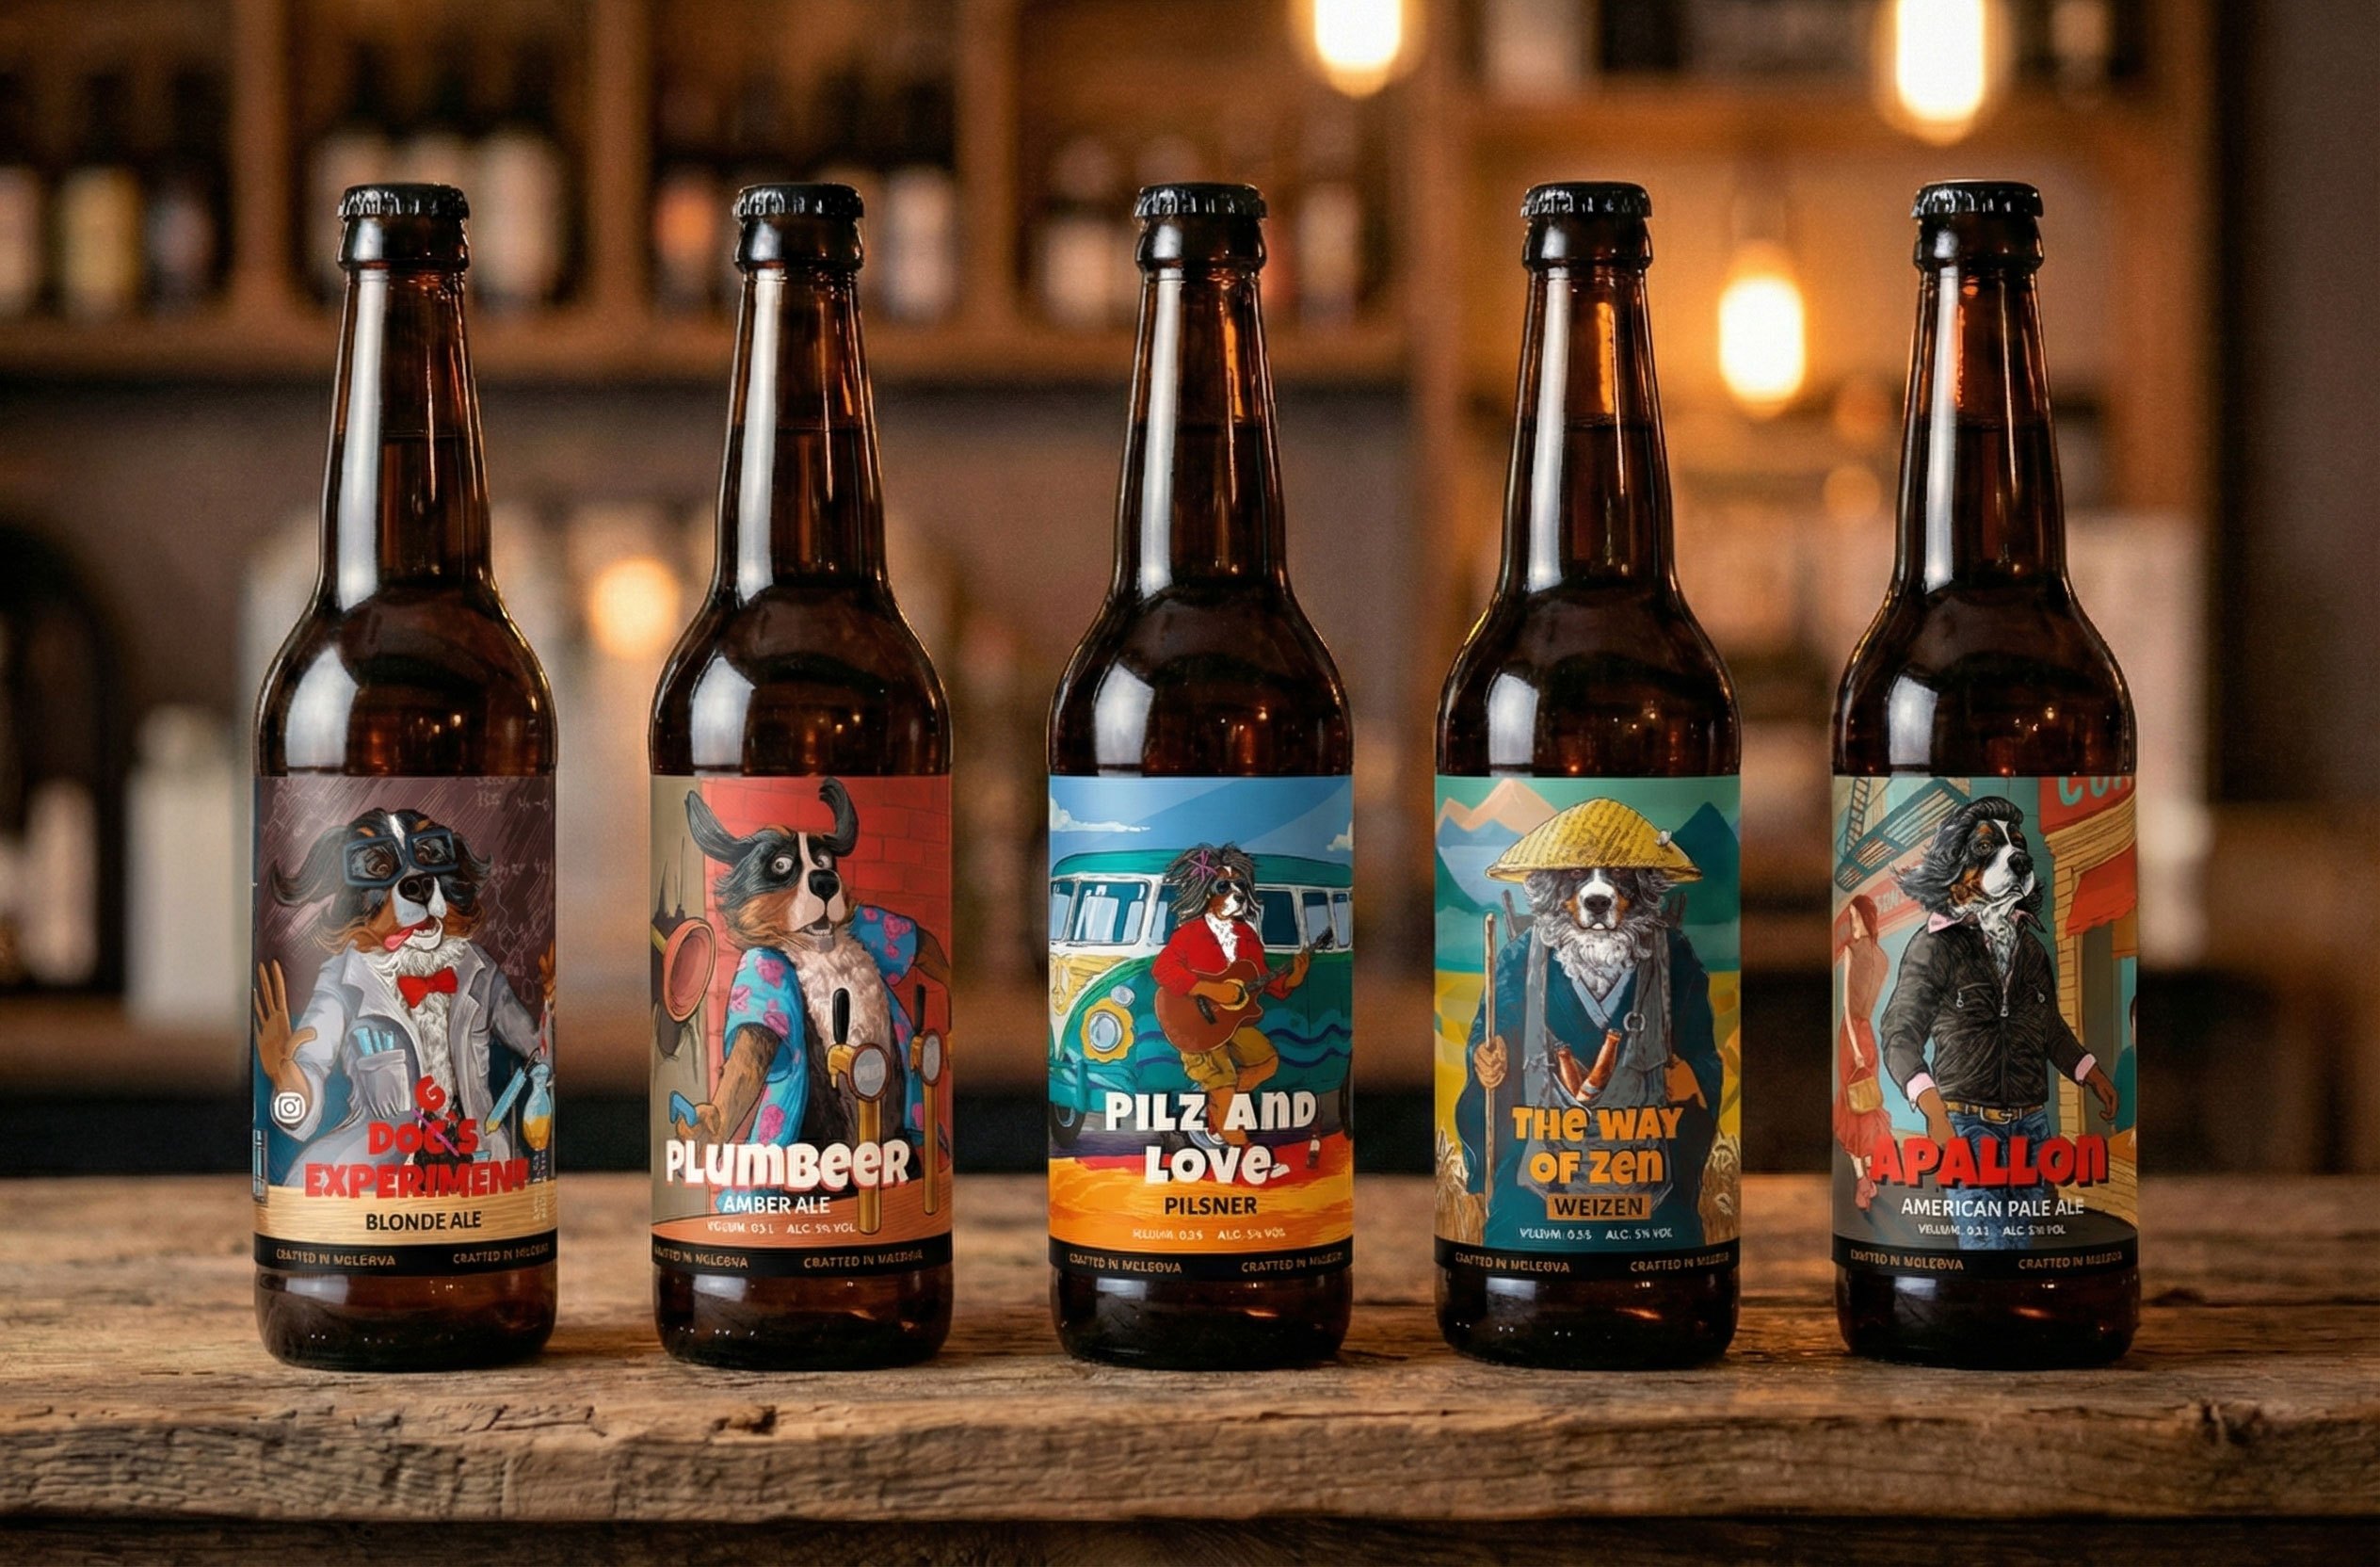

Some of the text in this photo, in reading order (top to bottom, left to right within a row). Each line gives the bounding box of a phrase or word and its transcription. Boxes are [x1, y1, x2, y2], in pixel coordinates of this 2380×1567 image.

[1105, 1091, 1208, 1131] PILZ
[1597, 1107, 1684, 1140] WAY
[1530, 1151, 1581, 1185] OF
[722, 1196, 831, 1215] AMBER ALE
[1165, 1196, 1258, 1216] PILSNER
[1554, 1197, 1644, 1217] WEIZEN
[1901, 1198, 2085, 1218] AMERICAN PALE ALE
[365, 1211, 483, 1231] BLONDE ALE
